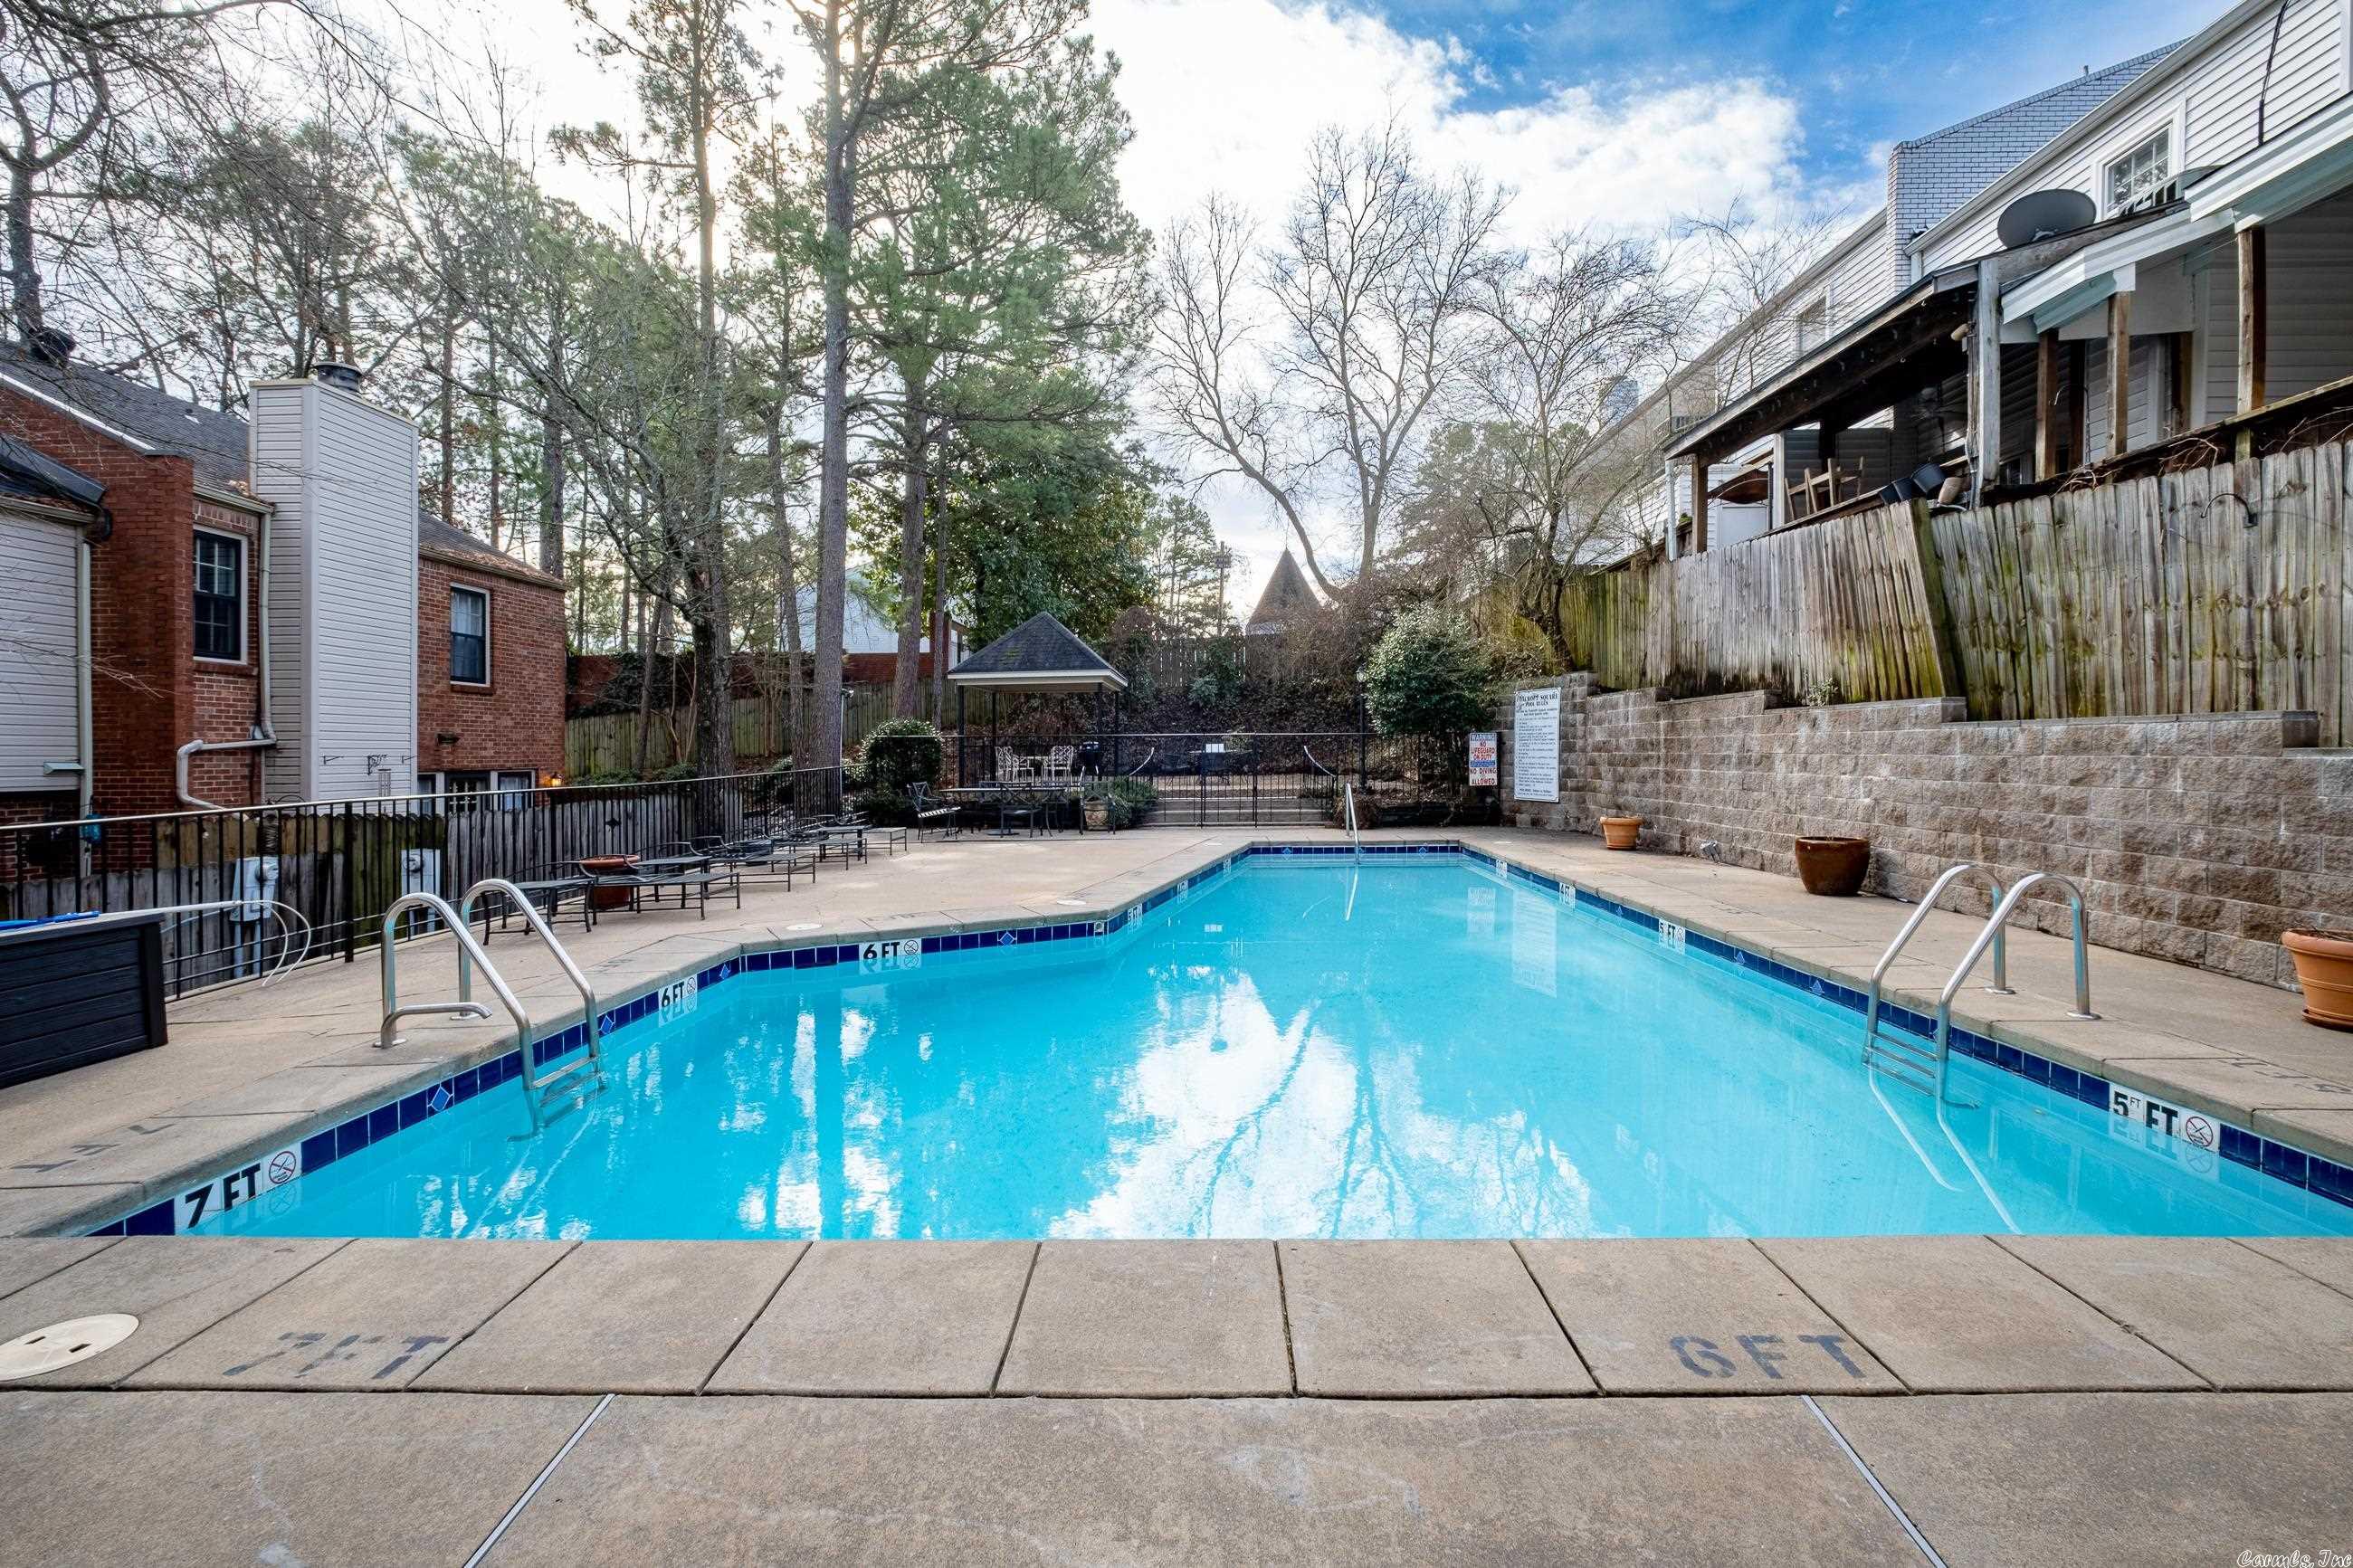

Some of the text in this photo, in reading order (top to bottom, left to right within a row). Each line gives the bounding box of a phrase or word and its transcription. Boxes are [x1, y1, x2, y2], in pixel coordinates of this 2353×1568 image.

[863, 941, 900, 959] 6 FT
[662, 981, 684, 1007] 6 FT
[2113, 1090, 2129, 1117] 5
[2146, 1100, 2178, 1136] FT
[185, 1163, 261, 1229] 7 FT
